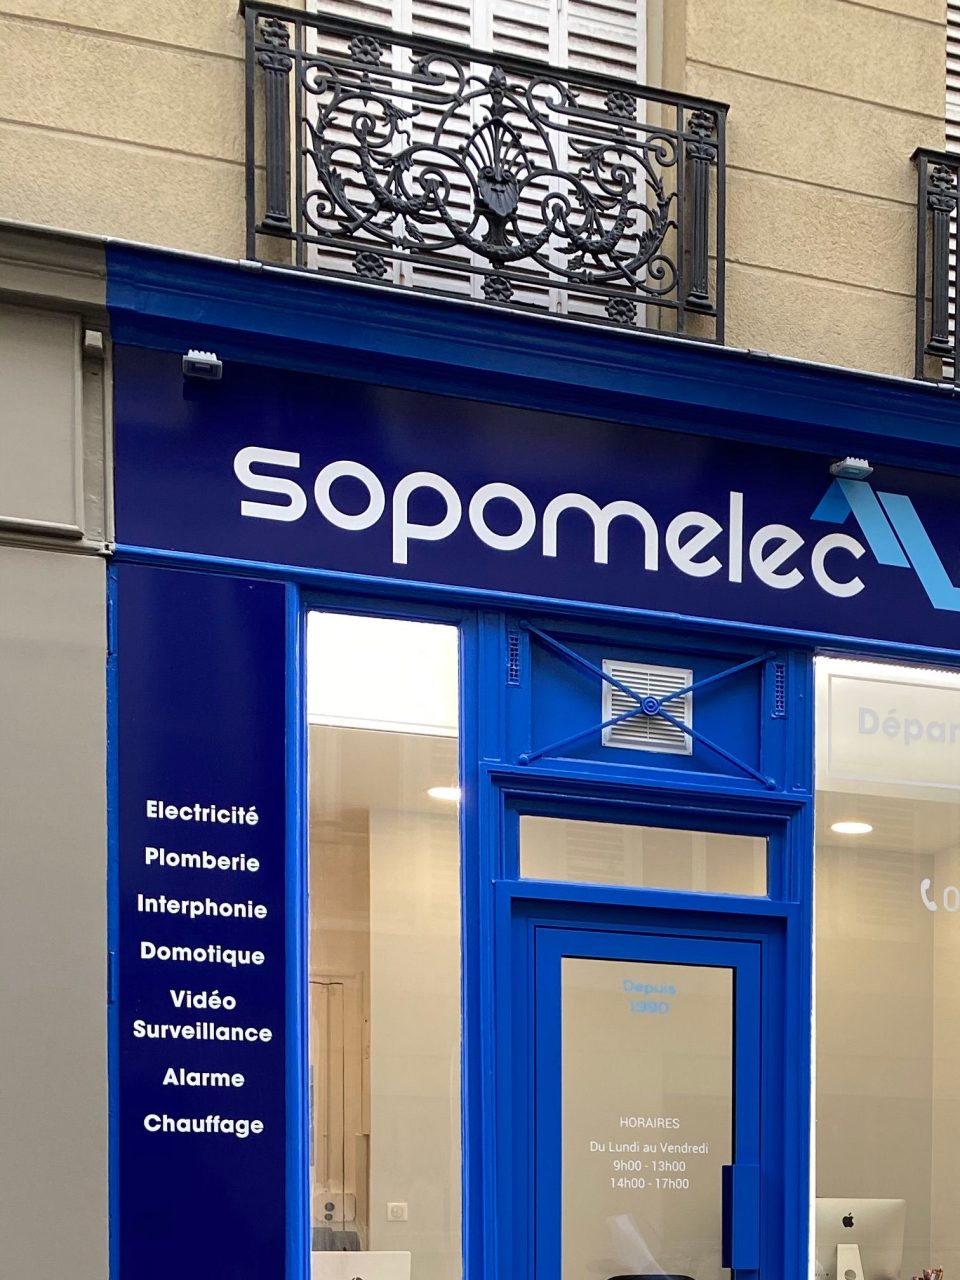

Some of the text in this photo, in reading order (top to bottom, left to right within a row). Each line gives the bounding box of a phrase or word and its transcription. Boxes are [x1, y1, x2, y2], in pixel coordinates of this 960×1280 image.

[147, 800, 258, 825] Electricité
[146, 847, 259, 871] Plomberie
[138, 894, 267, 918] Interphonie
[141, 942, 264, 967] Domotique
[623, 978, 677, 996] Depuis
[170, 990, 236, 1009] Vidéo
[134, 1020, 272, 1042] Surveillance
[163, 1068, 244, 1087] Alarme
[144, 1114, 263, 1138] Chauffage
[619, 1116, 680, 1129] HORAIRES
[590, 1140, 709, 1154] Du Lundi au Vendredi
[613, 1159, 642, 1171] 9h00
[652, 1160, 686, 1172] 13h00
[610, 1176, 645, 1189] 14h00
[655, 1177, 689, 1189] 17h00
